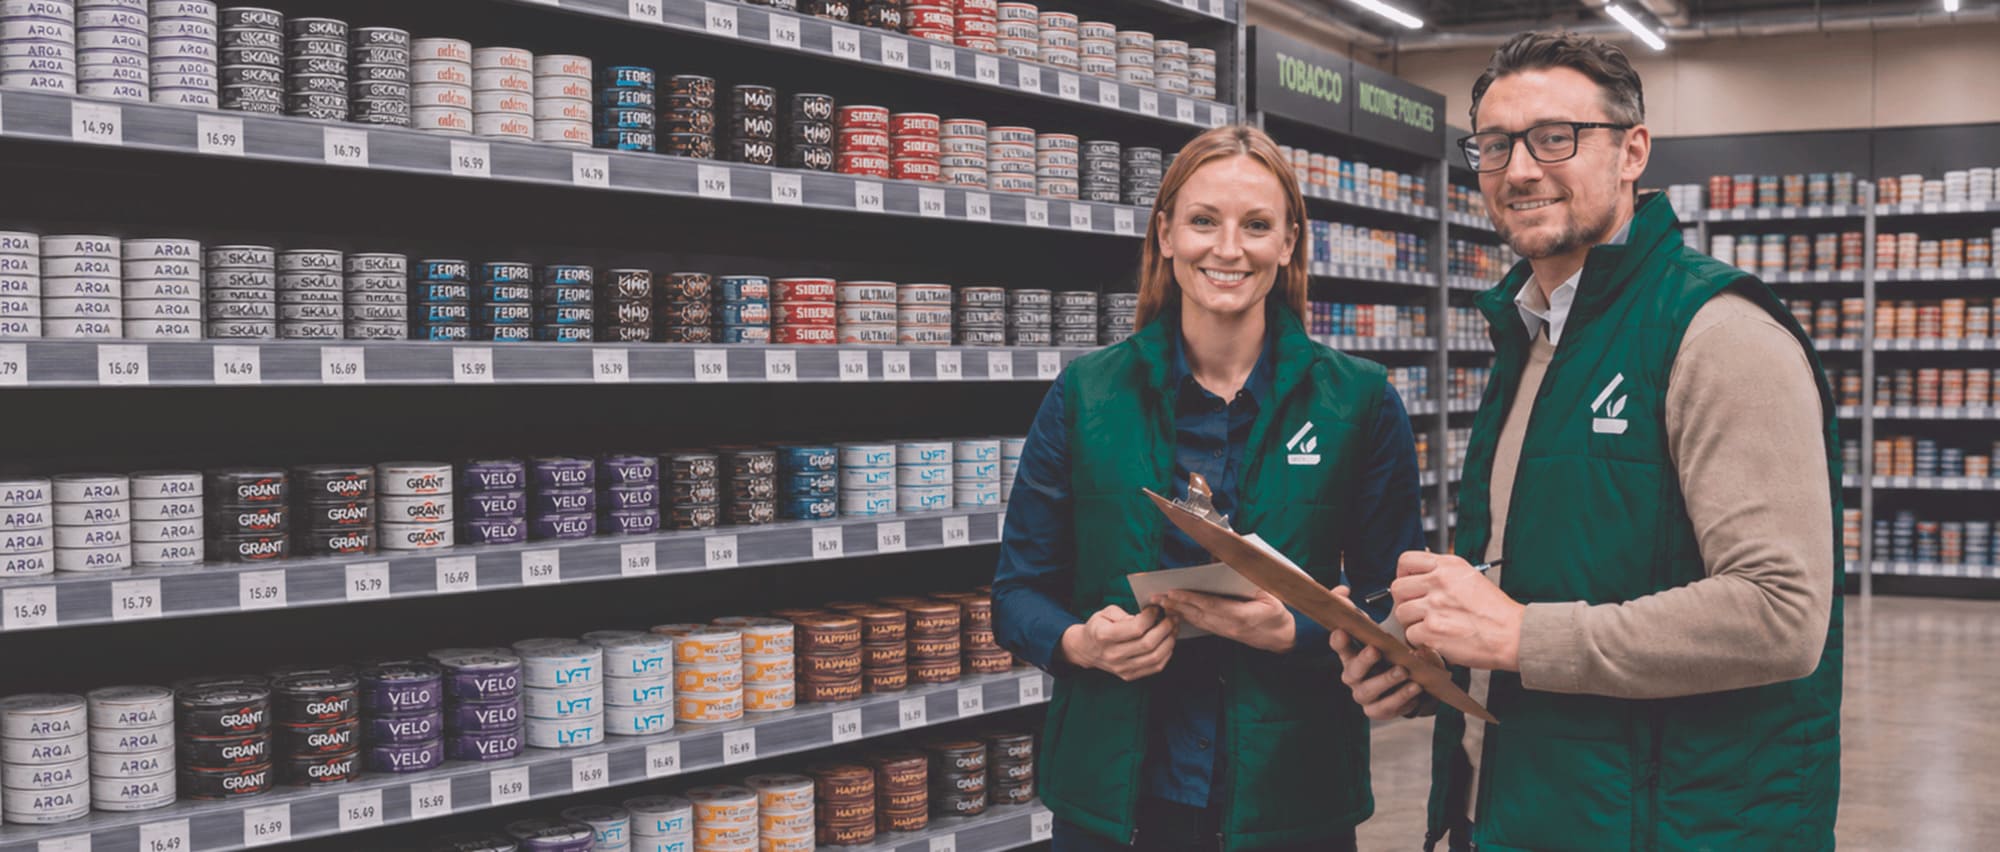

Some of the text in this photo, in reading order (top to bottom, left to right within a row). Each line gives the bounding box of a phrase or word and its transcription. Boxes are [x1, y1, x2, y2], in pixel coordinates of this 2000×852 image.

[28, 3, 62, 14] ARQA
[28, 25, 62, 36] ARQA
[28, 46, 62, 56] ARQA
[29, 60, 64, 70] ARQA
[30, 77, 64, 88] ARQA
[1276, 52, 1342, 104] TOBACCO
[82, 120, 114, 135] 14.99
[206, 132, 236, 146] 16.99
[334, 144, 360, 158] 16.79
[74, 242, 112, 253] ARQA
[154, 244, 190, 256] ARQA
[74, 262, 110, 273] ARQA
[154, 264, 190, 276] ARQA
[74, 282, 110, 294] ARQA
[154, 284, 190, 296] ARQA
[74, 303, 111, 314] ARQA
[155, 304, 190, 316] ARQA
[75, 323, 111, 334] ARQA
[156, 324, 190, 335] ARQA
[224, 362, 252, 375] 14.49
[480, 472, 516, 486] VELO
[552, 470, 586, 482] VELO
[619, 466, 652, 479] VELO
[160, 482, 195, 494] ARQA
[238, 482, 282, 498] GRANT
[326, 479, 368, 493] GRANT
[406, 477, 444, 489] GRANT
[4, 488, 43, 502] ARQA
[84, 485, 120, 498] ARQA
[619, 490, 652, 504] VELO
[480, 500, 517, 513] VELO
[552, 496, 587, 508] VELO
[84, 508, 120, 521] ARQA
[160, 504, 196, 516] ARQA
[328, 506, 368, 520] GRANT
[407, 504, 446, 517] GRANT
[5, 512, 44, 526] ARQA
[238, 512, 282, 527] GRANT
[620, 515, 653, 528] VELO
[160, 526, 196, 538] ARQA
[481, 524, 518, 538] VELO
[553, 520, 588, 534] VELO
[5, 535, 44, 548] ARQA
[85, 530, 122, 544] ARQA
[328, 534, 368, 549] GRANT
[408, 530, 446, 544] GRANT
[161, 546, 196, 558] ARQA
[239, 540, 284, 554] GRANT
[6, 558, 44, 572] ARQA
[86, 553, 122, 566] ARQA
[354, 578, 382, 592] 15.79
[122, 596, 152, 610] 15.79
[14, 604, 46, 618] 15.49
[632, 657, 664, 673] LYFT
[556, 666, 592, 684] LYFT
[474, 676, 516, 692] VELO
[388, 690, 430, 706] VELO
[633, 686, 664, 702] LYFT
[306, 698, 350, 716] GRANT
[557, 697, 592, 714] LYFT
[118, 710, 158, 724] ARQA
[220, 710, 264, 728] GRANT
[476, 707, 518, 724] VELO
[634, 714, 665, 730] LYFT
[30, 720, 72, 734] ARQA
[388, 720, 430, 736] VELO
[120, 734, 158, 748] ARQA
[308, 730, 351, 746] GRANT
[558, 727, 593, 744] LYFT
[32, 744, 72, 759] ARQA
[222, 742, 264, 760] GRANT
[476, 738, 518, 754] VELO
[120, 758, 158, 772] ARQA
[390, 750, 431, 766] VELO
[32, 768, 72, 784] ARQA
[308, 761, 352, 778] GRANT
[580, 769, 602, 782] 16.99
[223, 772, 266, 790] GRANT
[121, 782, 159, 796] ARQA
[34, 794, 74, 809] ARQA
[658, 818, 684, 832] LYFT
[151, 837, 181, 852] 16.49
